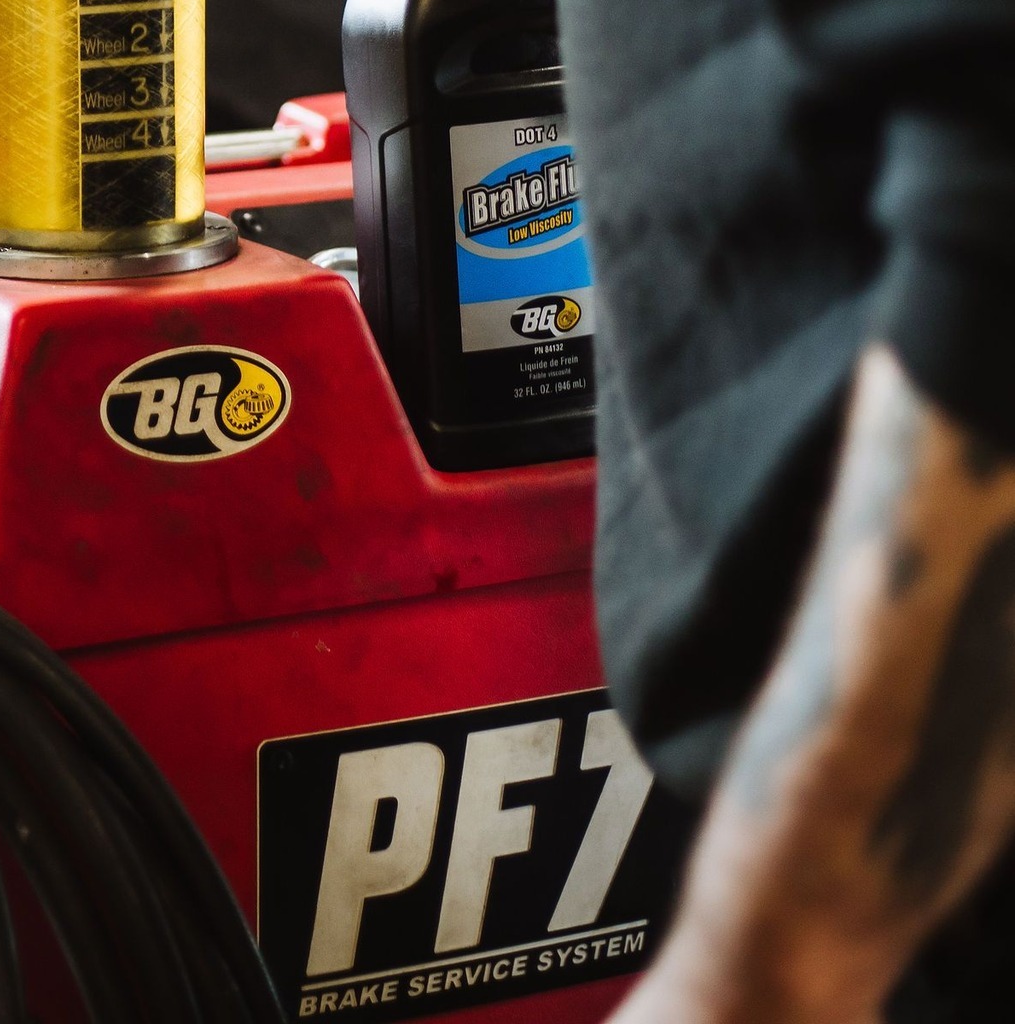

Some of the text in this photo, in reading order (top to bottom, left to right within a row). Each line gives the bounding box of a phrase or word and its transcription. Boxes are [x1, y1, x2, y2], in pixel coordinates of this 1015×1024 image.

[84, 22, 149, 56] Wheel 2
[84, 76, 150, 109] Wheel 3
[85, 118, 152, 151] Wheel 4
[515, 124, 558, 146] DOT 4
[470, 176, 543, 228] Brake
[508, 208, 573, 243] Low Viscosity
[514, 304, 559, 334] BG
[519, 355, 579, 372] Liquide de Frein
[534, 343, 564, 354] PN 84132
[513, 387, 524, 398] 32
[525, 385, 538, 396] FL.
[554, 380, 571, 394] (946
[572, 378, 586, 389] mL)
[112, 371, 222, 441] BG
[306, 708, 655, 976] PF7
[299, 931, 646, 1017] BRAKE SERVICE SYSTEM
